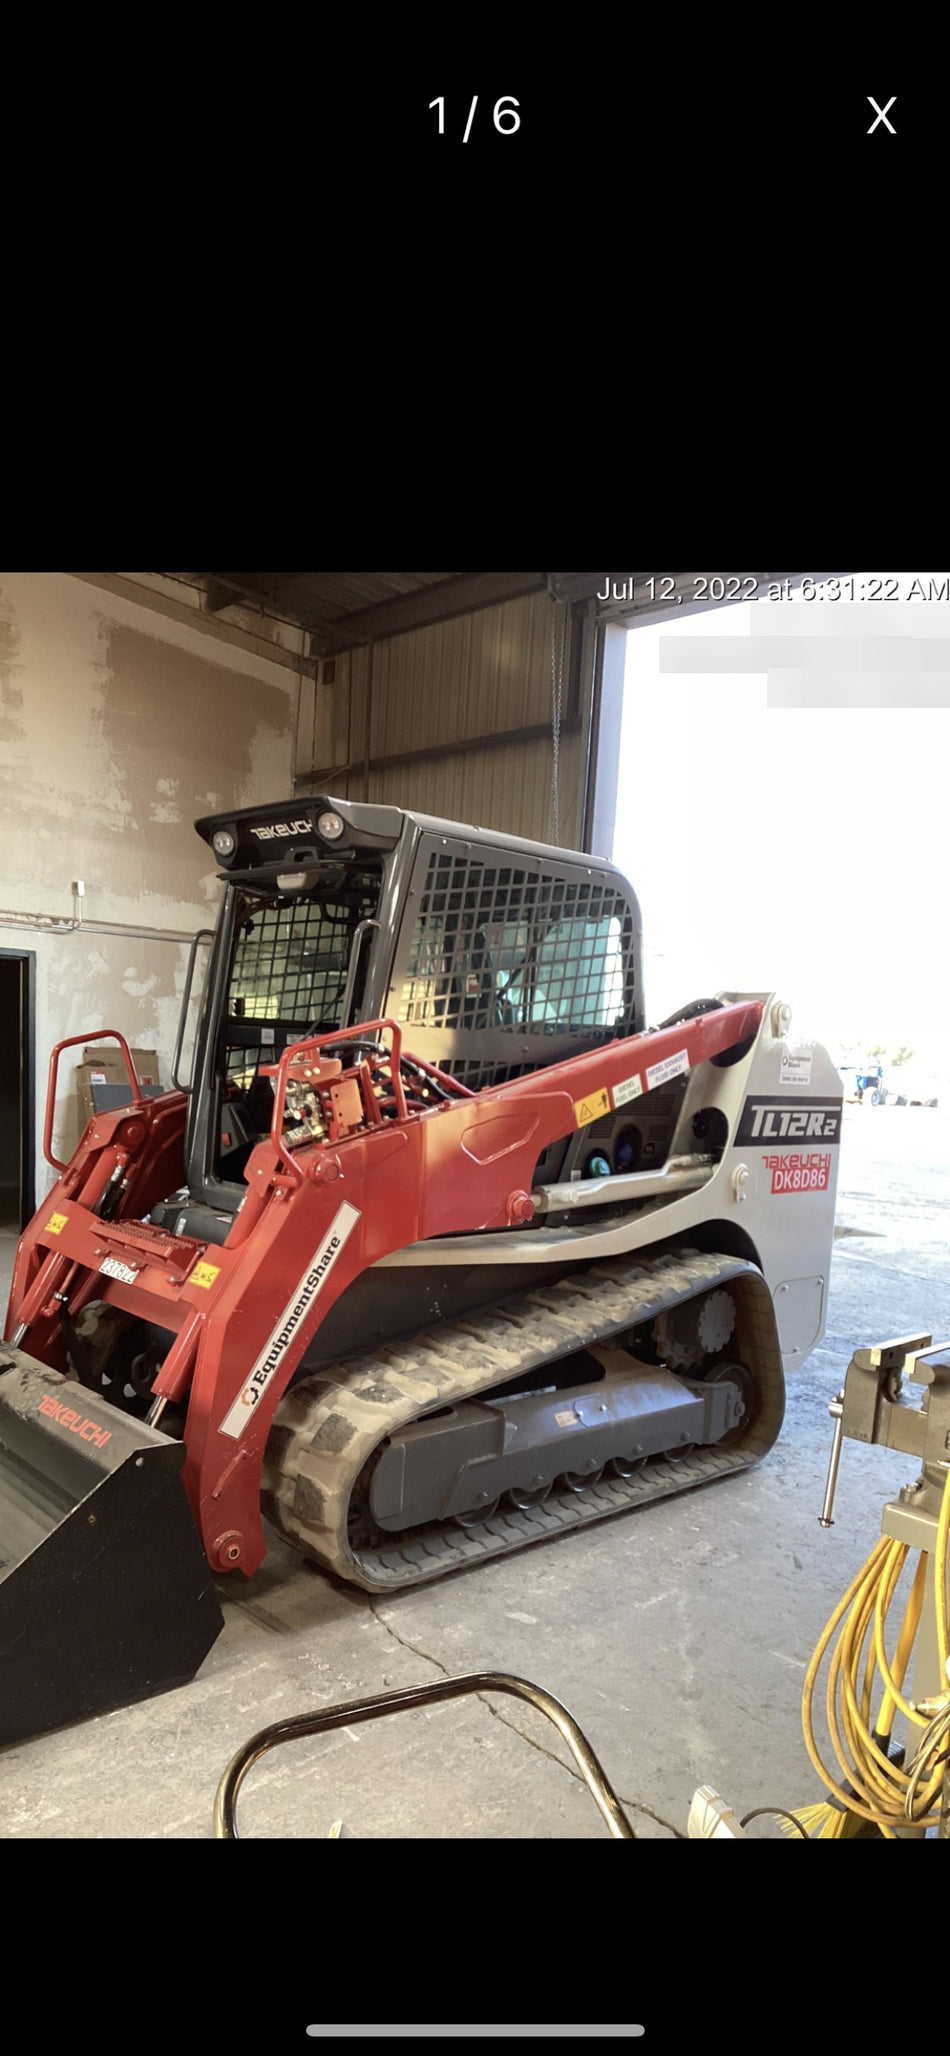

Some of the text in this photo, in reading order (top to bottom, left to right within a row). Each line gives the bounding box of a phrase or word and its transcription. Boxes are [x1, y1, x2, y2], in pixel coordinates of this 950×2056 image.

[647, 1051, 687, 1077] DIESEL EXHAUST
[751, 1105, 841, 1138] TL12R2
[774, 1168, 826, 1191] DK8D86
[252, 1235, 341, 1386] EquipmentShare
